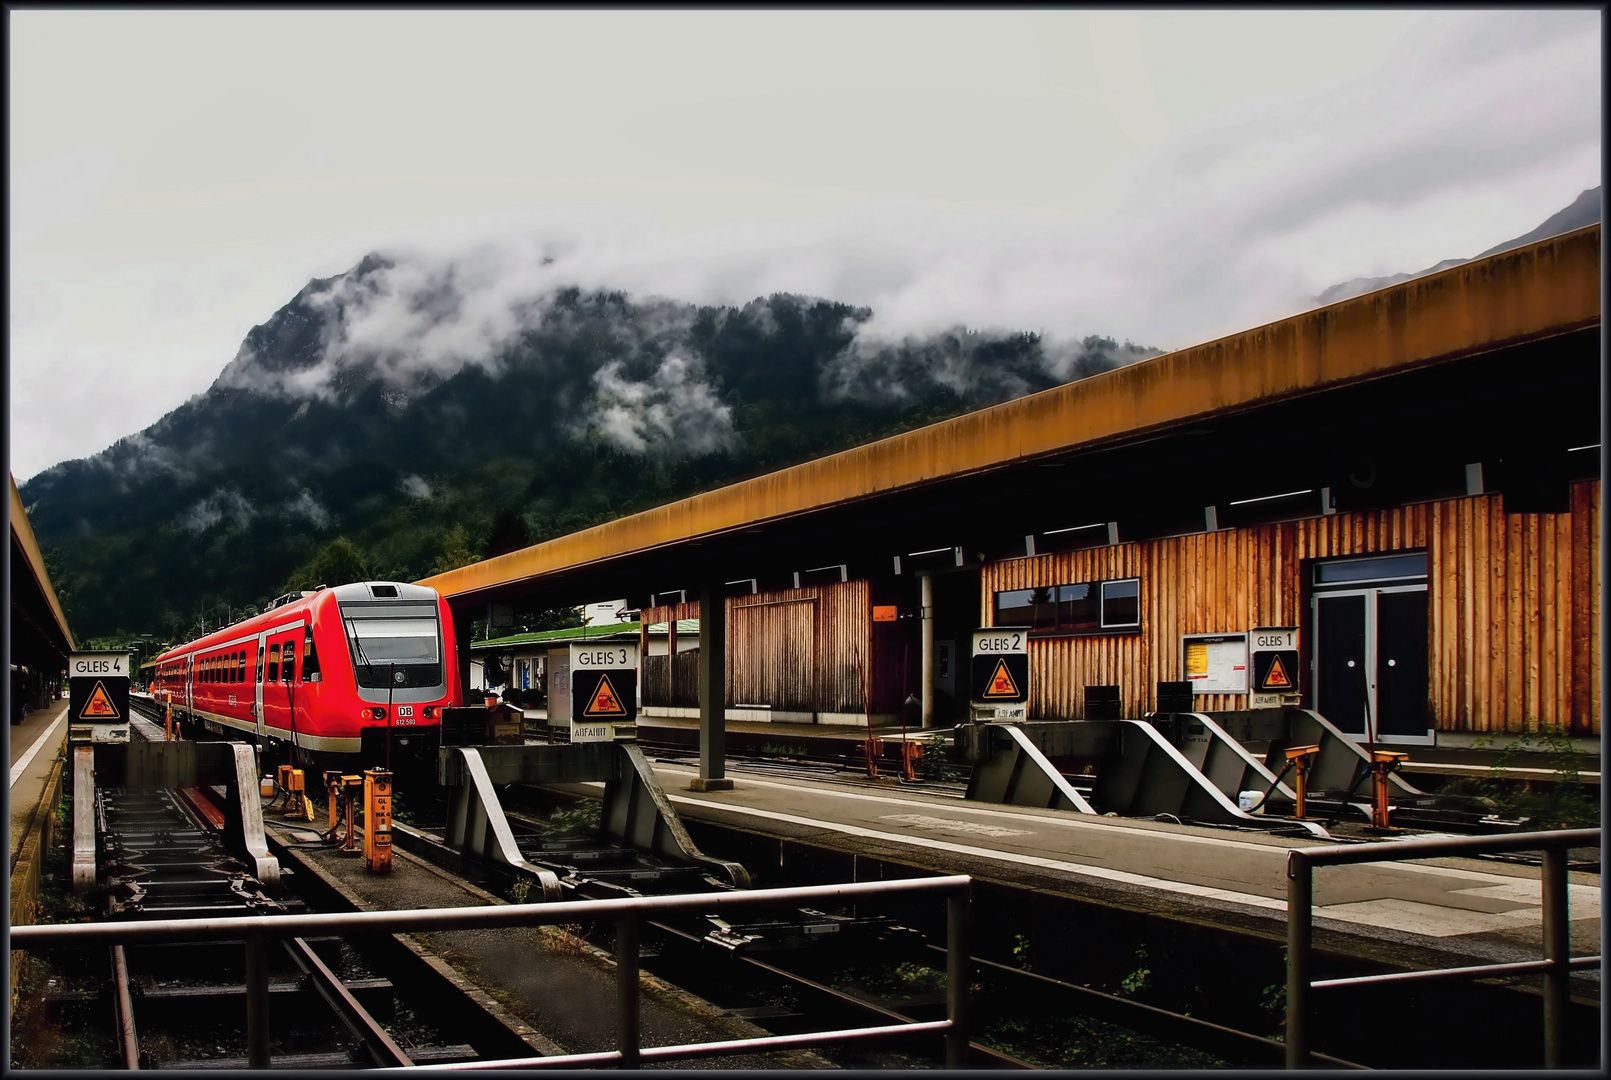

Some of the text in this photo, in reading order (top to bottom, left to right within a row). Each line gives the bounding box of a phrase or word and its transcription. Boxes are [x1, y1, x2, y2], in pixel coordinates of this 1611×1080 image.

[979, 634, 1020, 651] GLEIS 2
[1257, 633, 1292, 647] GLEIS 1
[579, 649, 627, 665] GLEIS 3
[76, 658, 121, 673] GLEIS 4
[399, 707, 412, 716] DB
[574, 728, 607, 737] ABFAHRT
